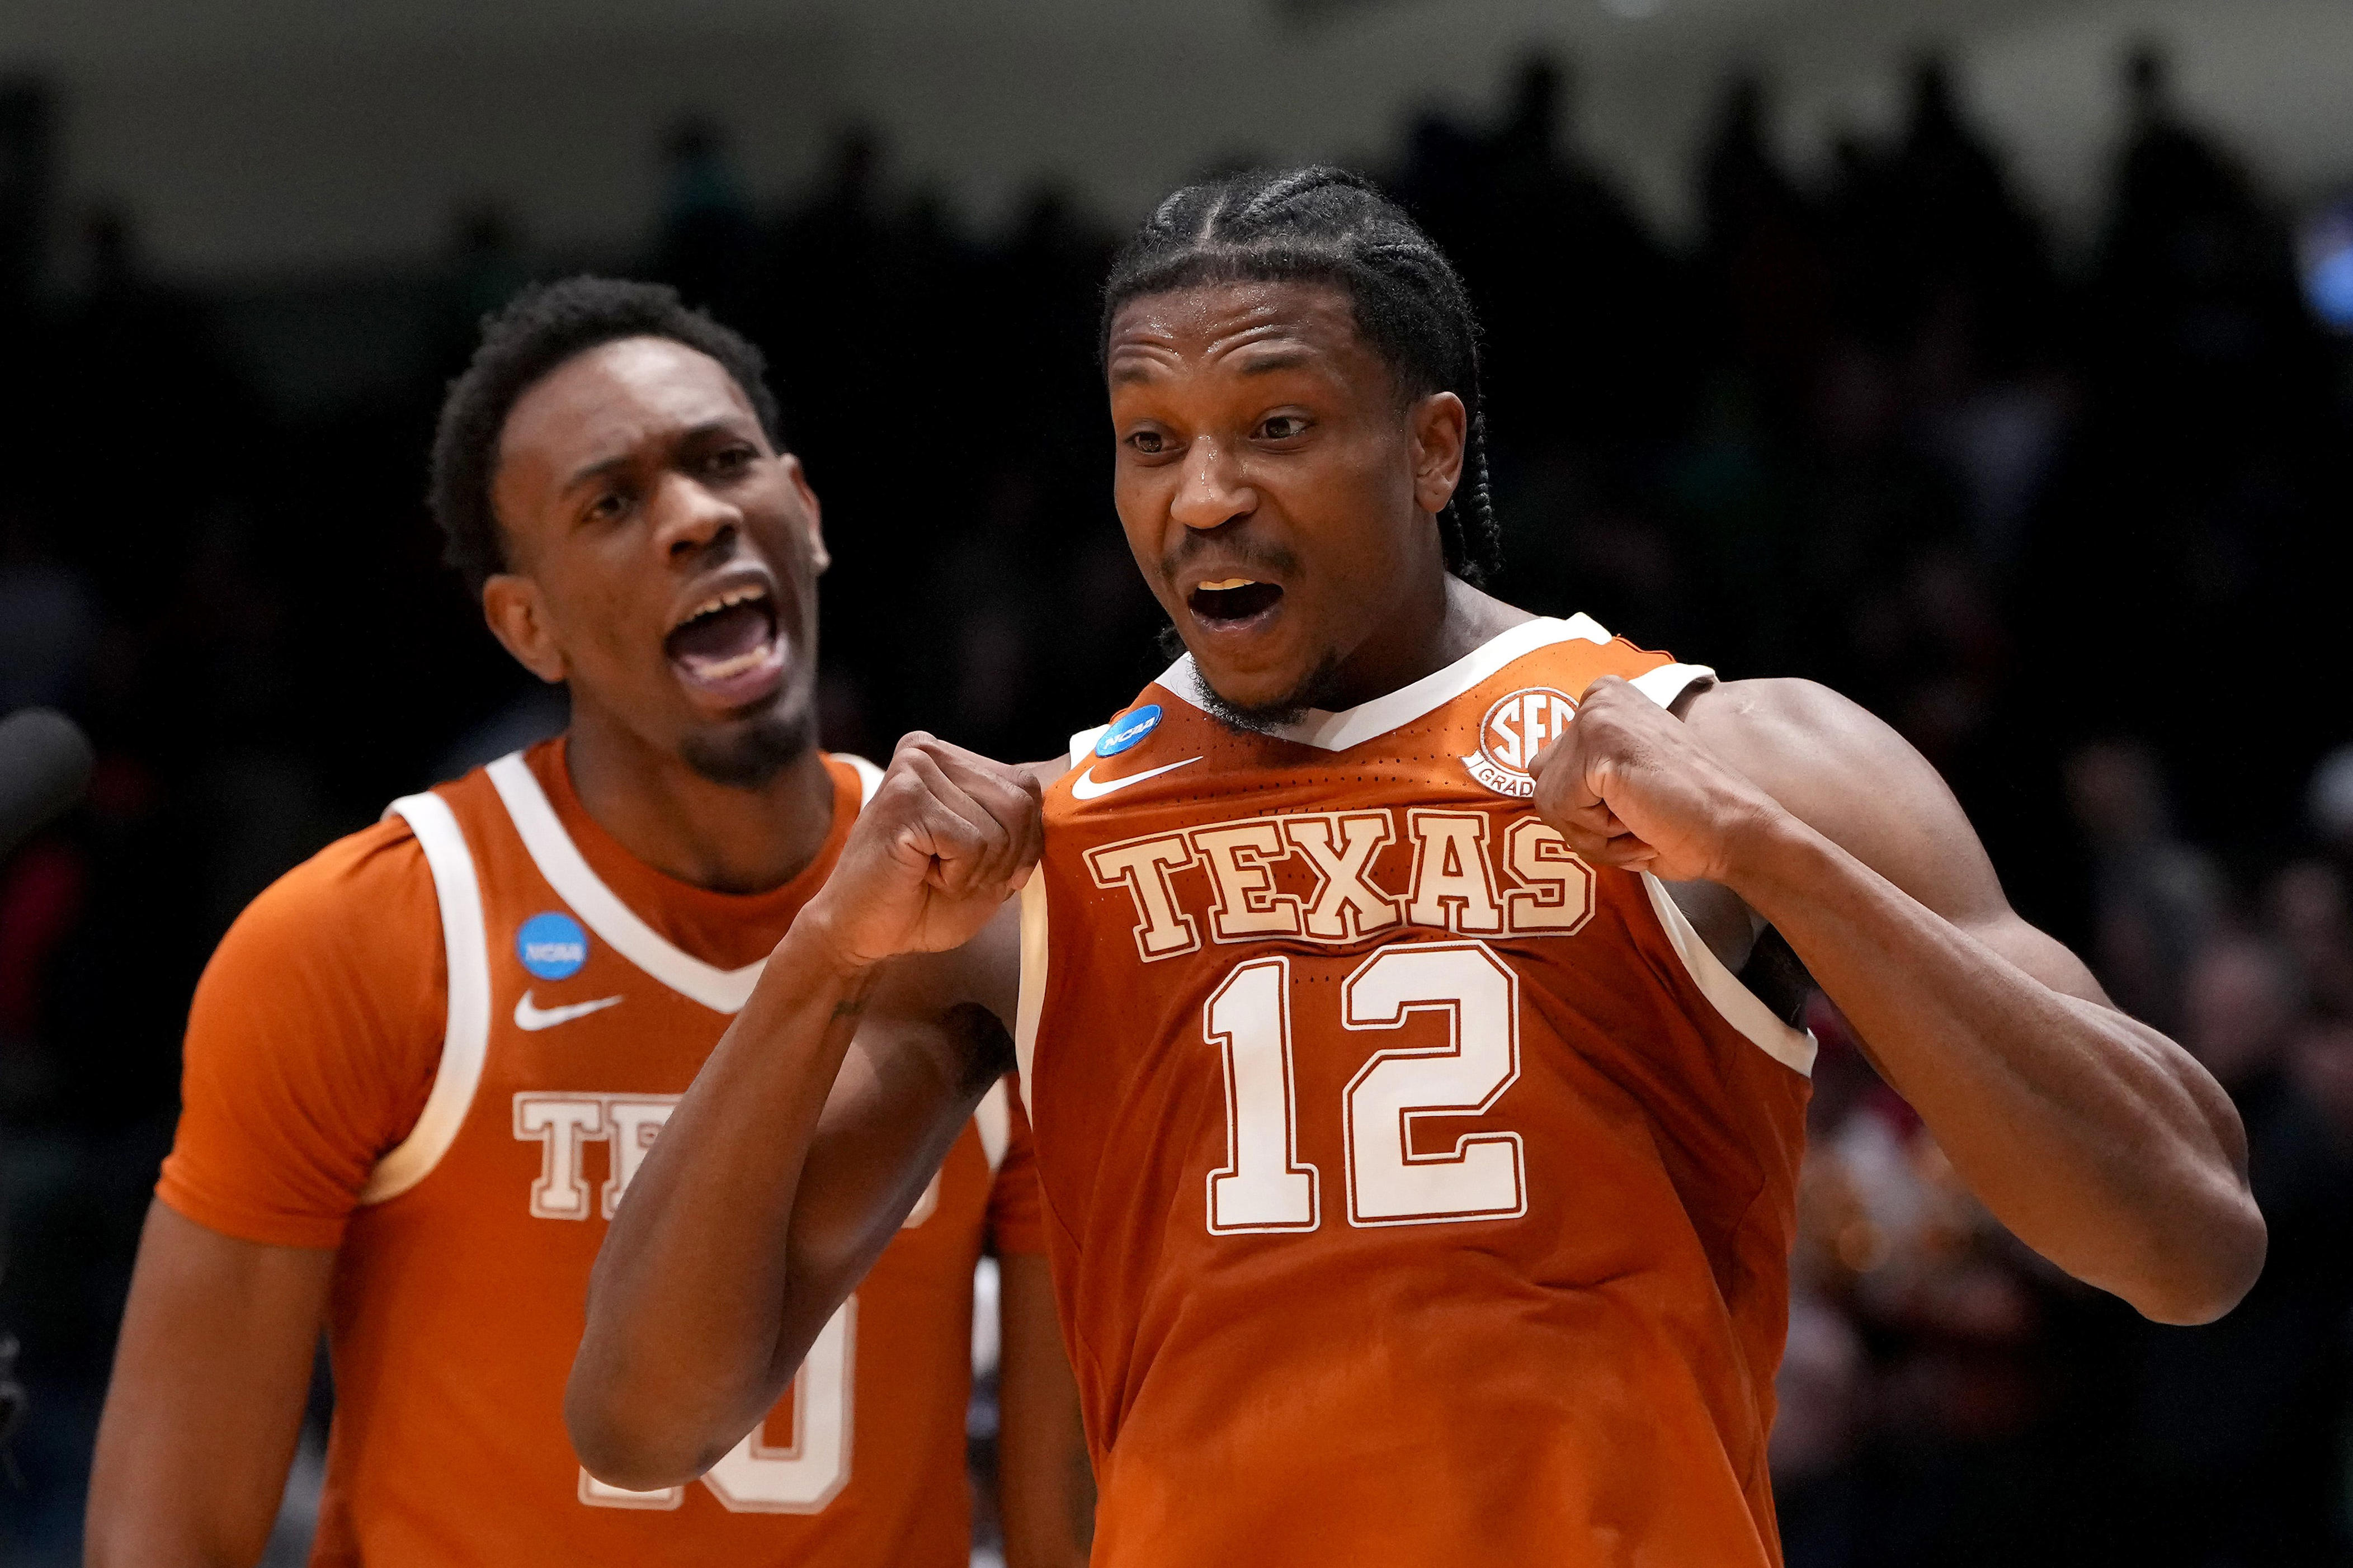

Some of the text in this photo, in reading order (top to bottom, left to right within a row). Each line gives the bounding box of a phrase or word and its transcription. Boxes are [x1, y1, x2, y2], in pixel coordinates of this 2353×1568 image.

[1104, 716, 1156, 749] NCAA
[1478, 768, 1534, 796] GRAD
[1082, 807, 1596, 964] TEXAS
[1203, 939, 1528, 1236] 12
